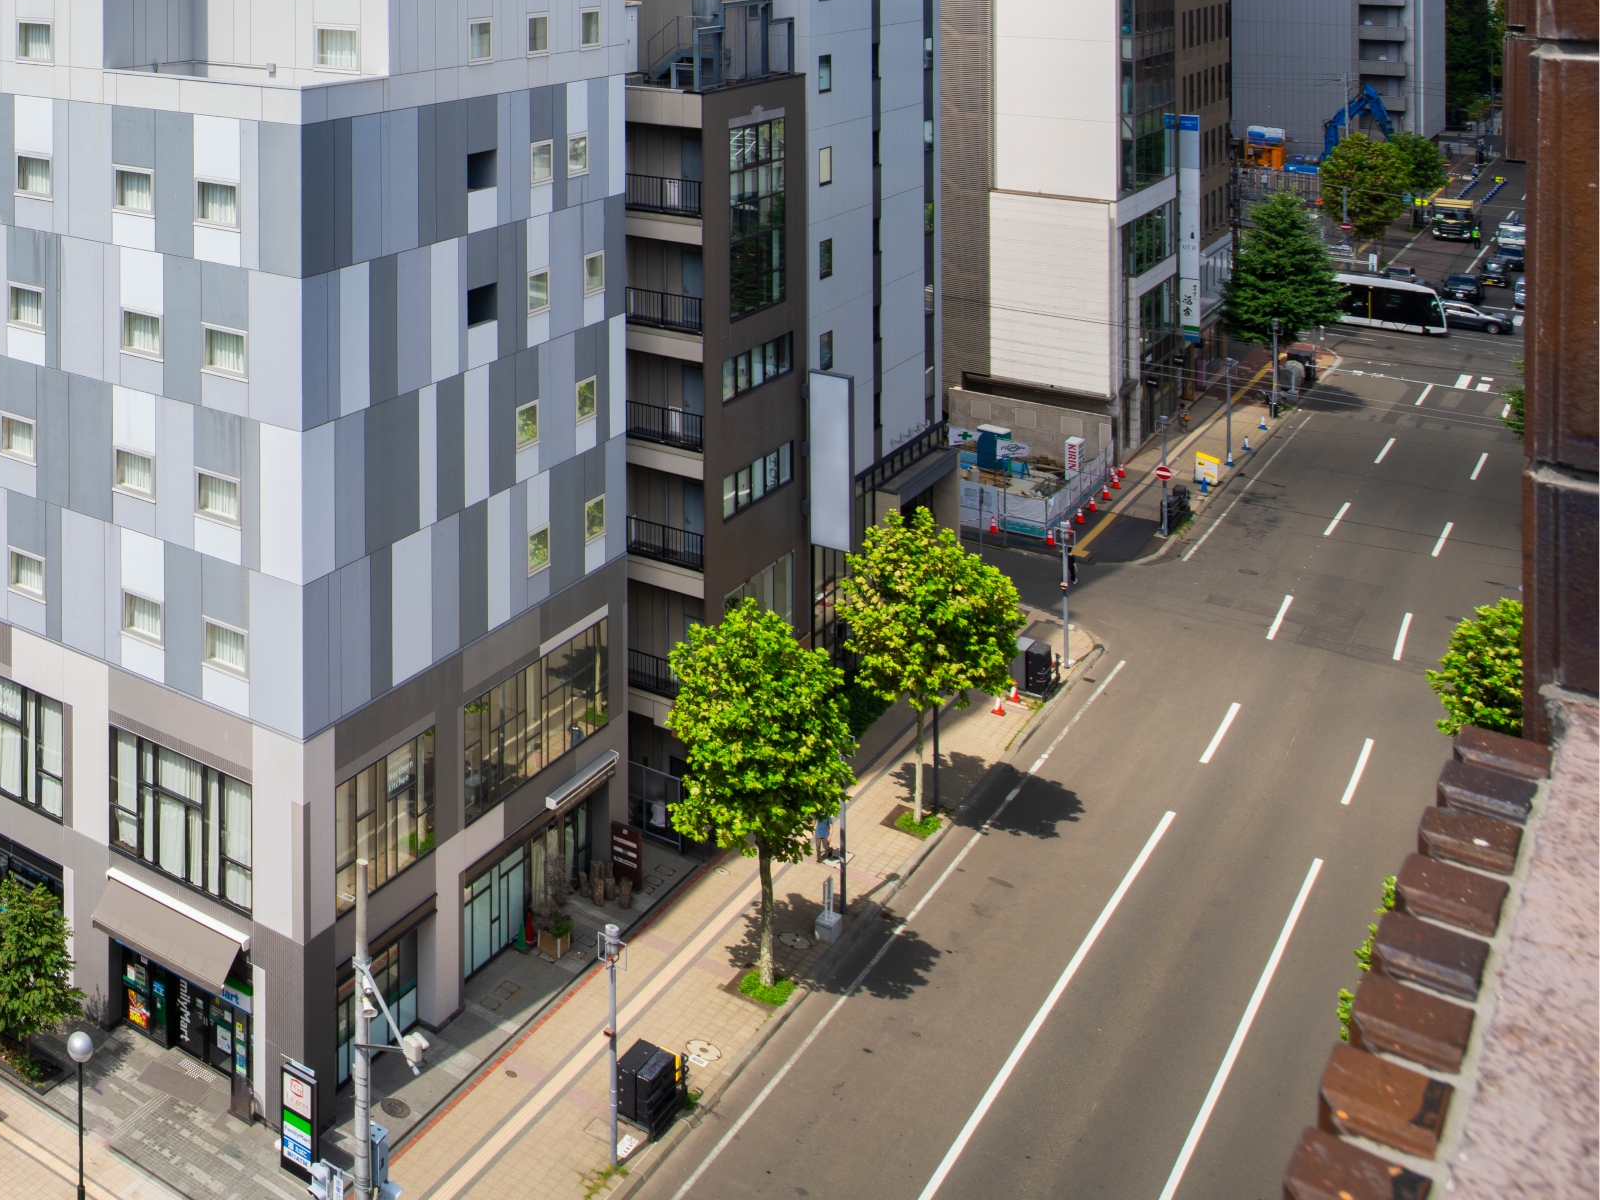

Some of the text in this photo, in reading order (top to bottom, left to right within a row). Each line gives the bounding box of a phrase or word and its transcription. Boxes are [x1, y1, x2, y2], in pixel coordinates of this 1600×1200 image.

[1068, 443, 1077, 471] KIRIN
[388, 760, 414, 781] Northern
[388, 774, 409, 793] kitchen
[222, 988, 240, 1005] art
[286, 1091, 309, 1111] La'gent
[284, 1124, 311, 1145] FamilyMart
